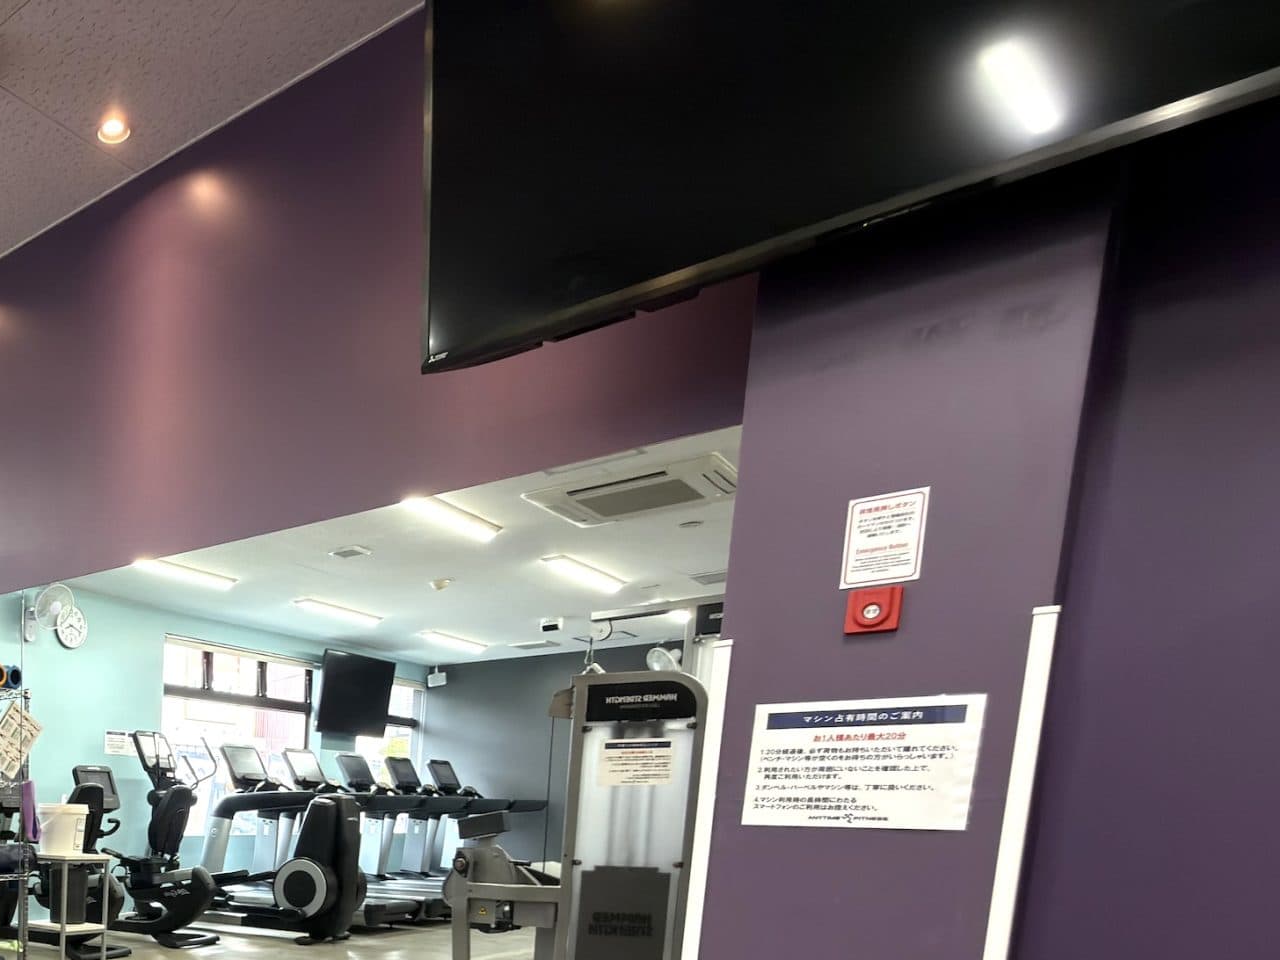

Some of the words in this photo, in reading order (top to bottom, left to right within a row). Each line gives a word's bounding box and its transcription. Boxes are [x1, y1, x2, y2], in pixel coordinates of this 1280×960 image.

[803, 711, 924, 724] マシン占有時間のご案内
